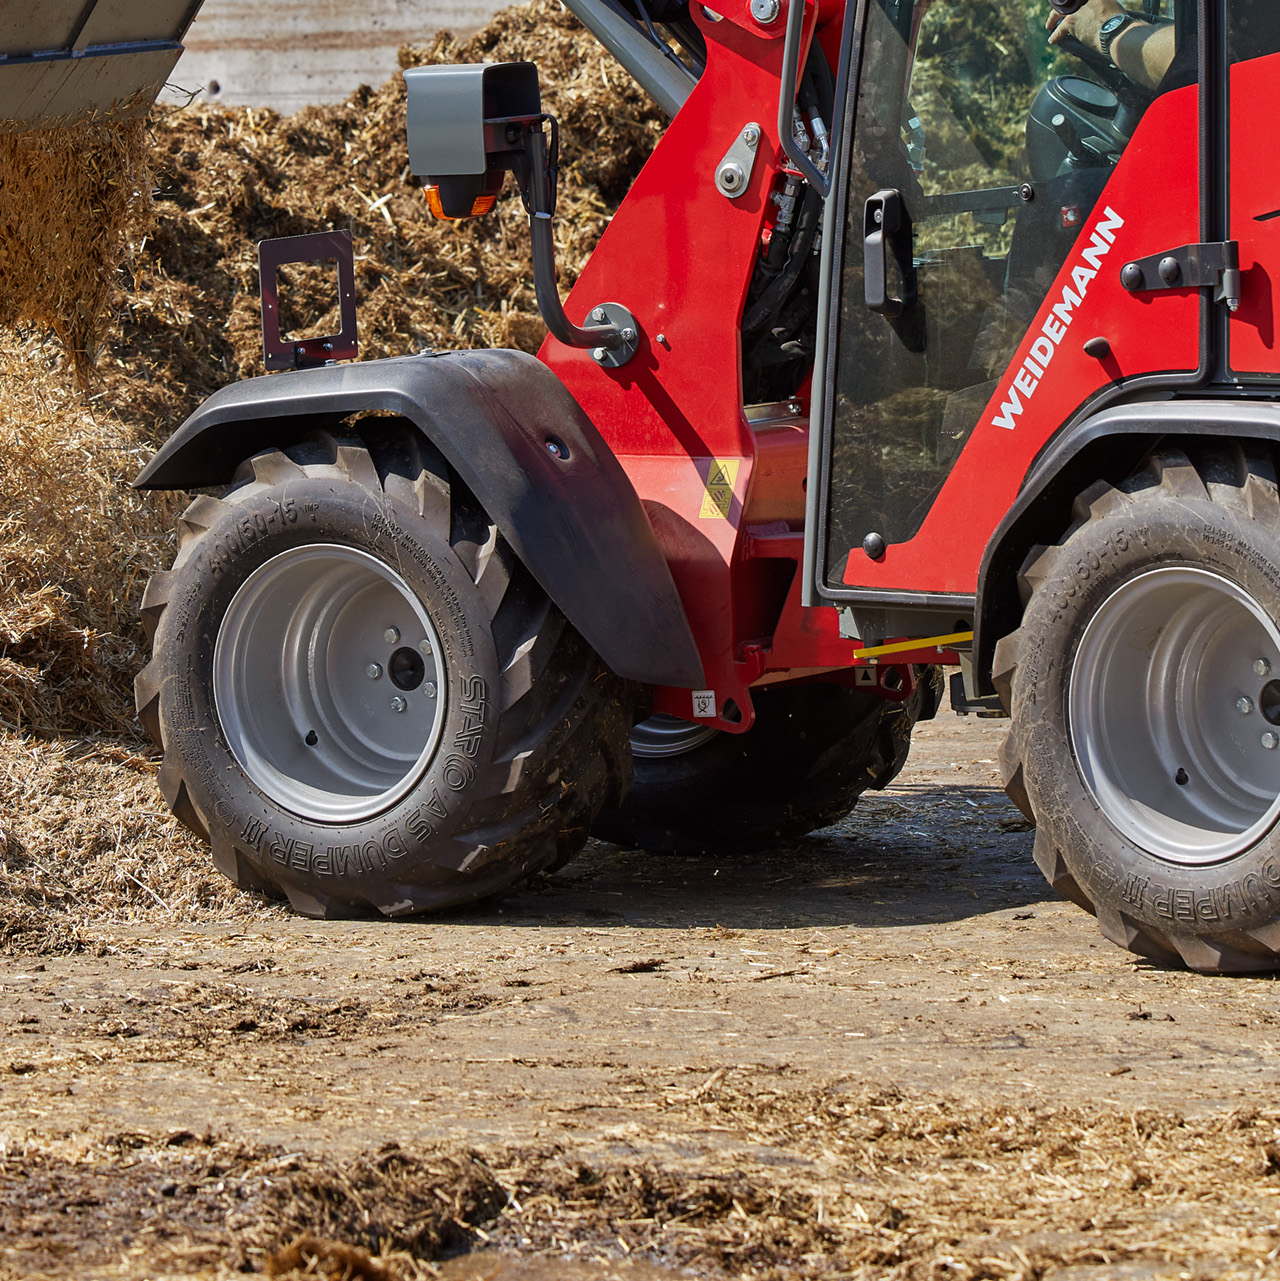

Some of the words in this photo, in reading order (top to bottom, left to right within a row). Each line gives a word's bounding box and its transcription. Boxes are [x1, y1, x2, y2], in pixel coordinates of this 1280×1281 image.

[991, 206, 1125, 431] WEIDEMANN
[208, 498, 299, 576] 400/50-15
[402, 532, 418, 548] MAX
[240, 814, 271, 853] II
[407, 786, 449, 844] AS
[269, 827, 409, 875] DUMPER
[1121, 870, 1152, 910] II
